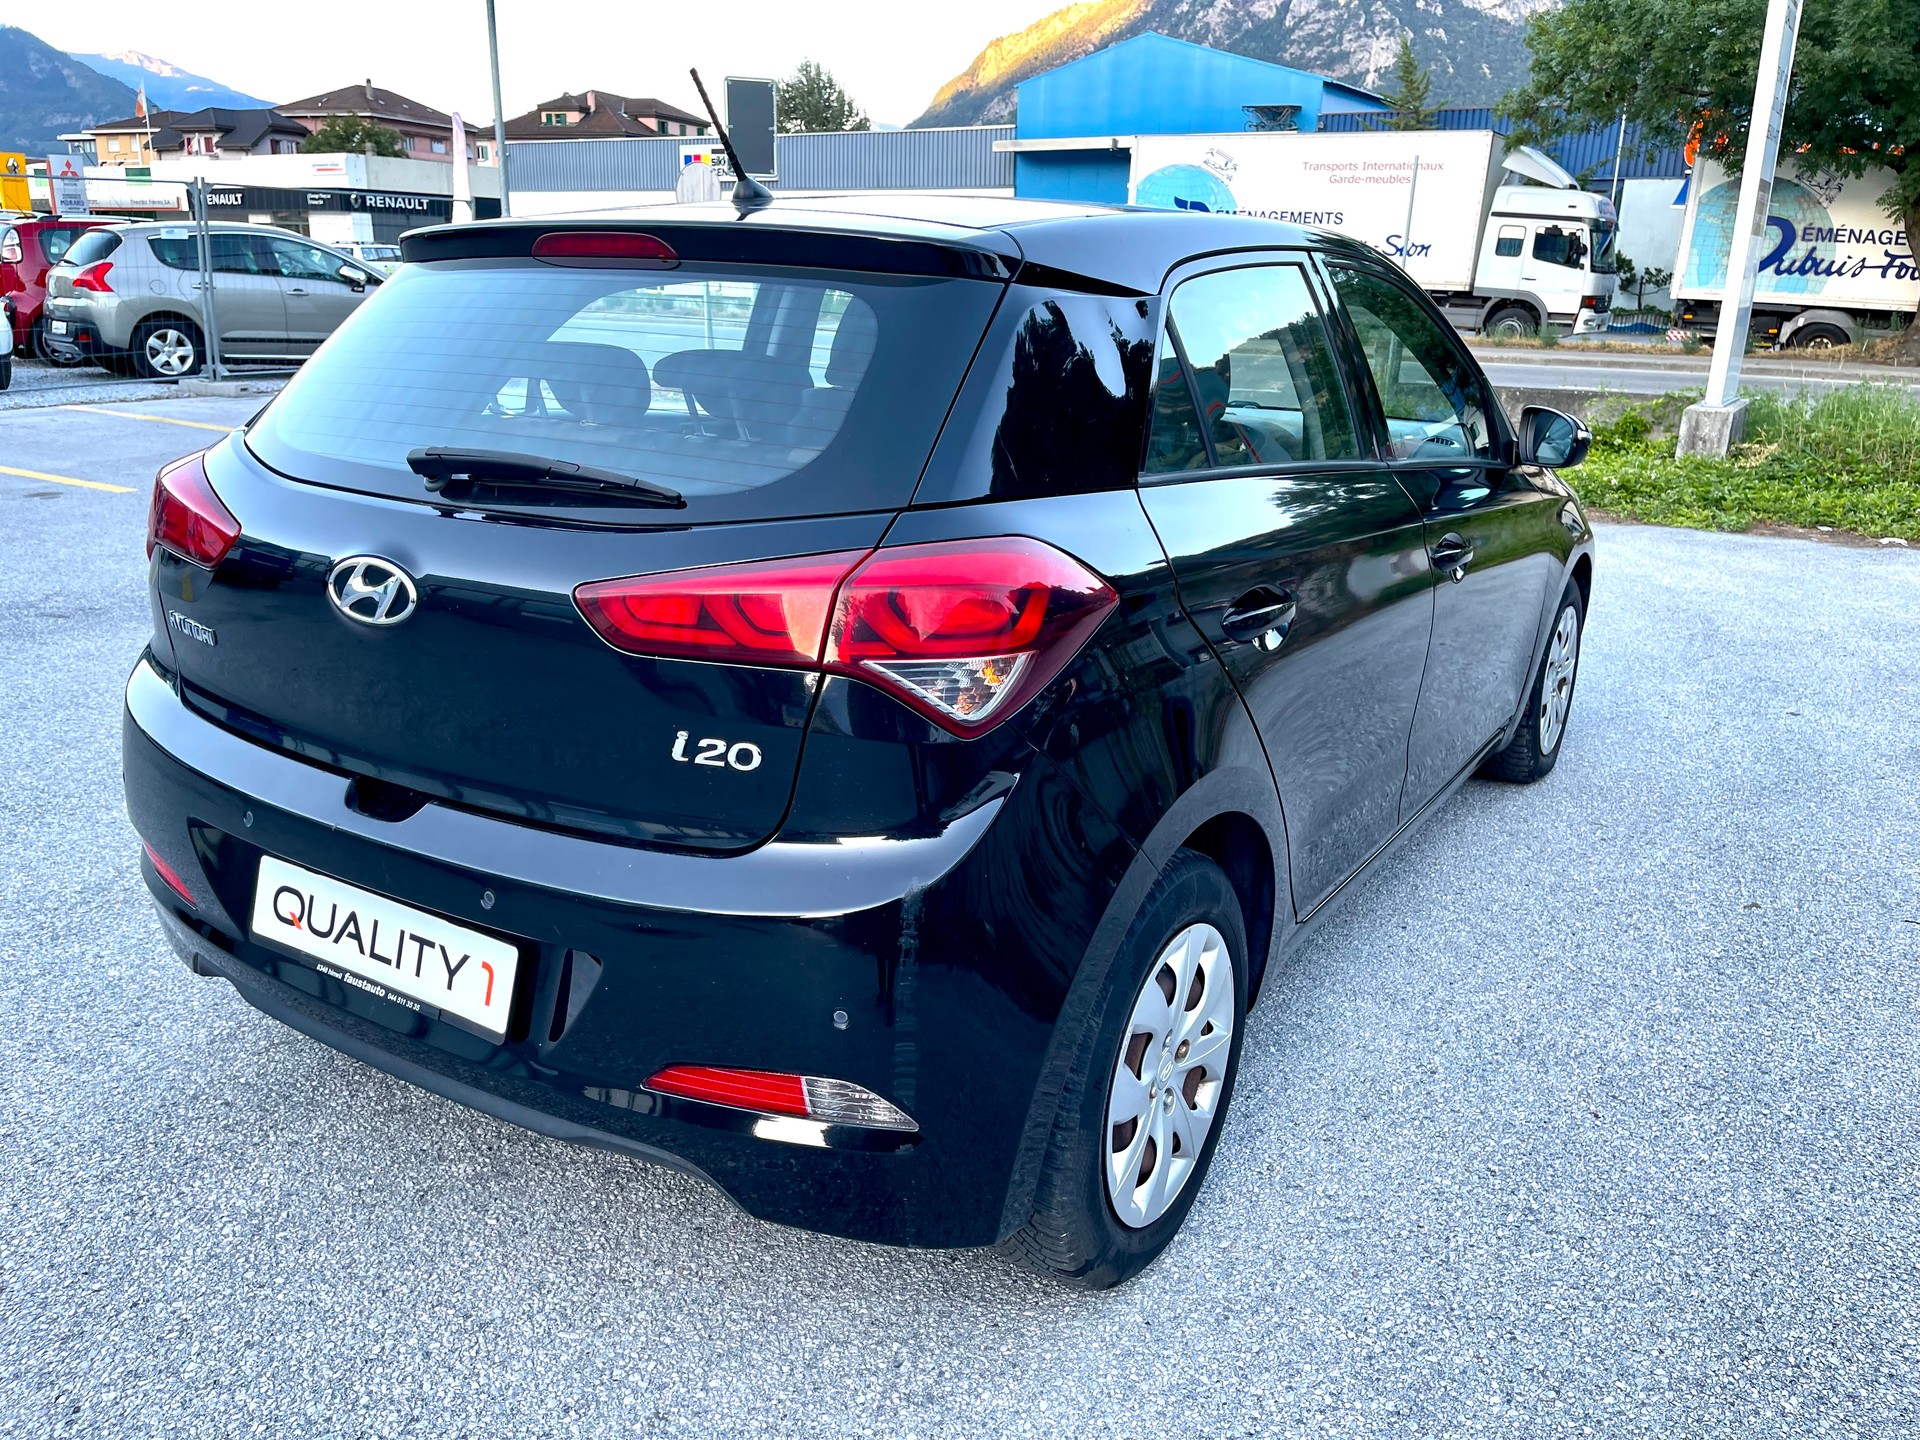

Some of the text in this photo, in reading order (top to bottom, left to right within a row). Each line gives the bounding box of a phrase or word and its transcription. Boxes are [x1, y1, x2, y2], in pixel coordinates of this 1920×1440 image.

[1302, 162, 1358, 172] Transports
[1329, 175, 1411, 184] Garde-meubles
[207, 193, 243, 206] ENAULT
[365, 195, 430, 210] RENAULT
[168, 610, 217, 647] HYUNDAI
[272, 885, 471, 991] QUALITY
[316, 963, 329, 974] 8340
[343, 972, 386, 997] faustauto
[387, 992, 398, 1002] 044
[396, 996, 407, 1006] 511
